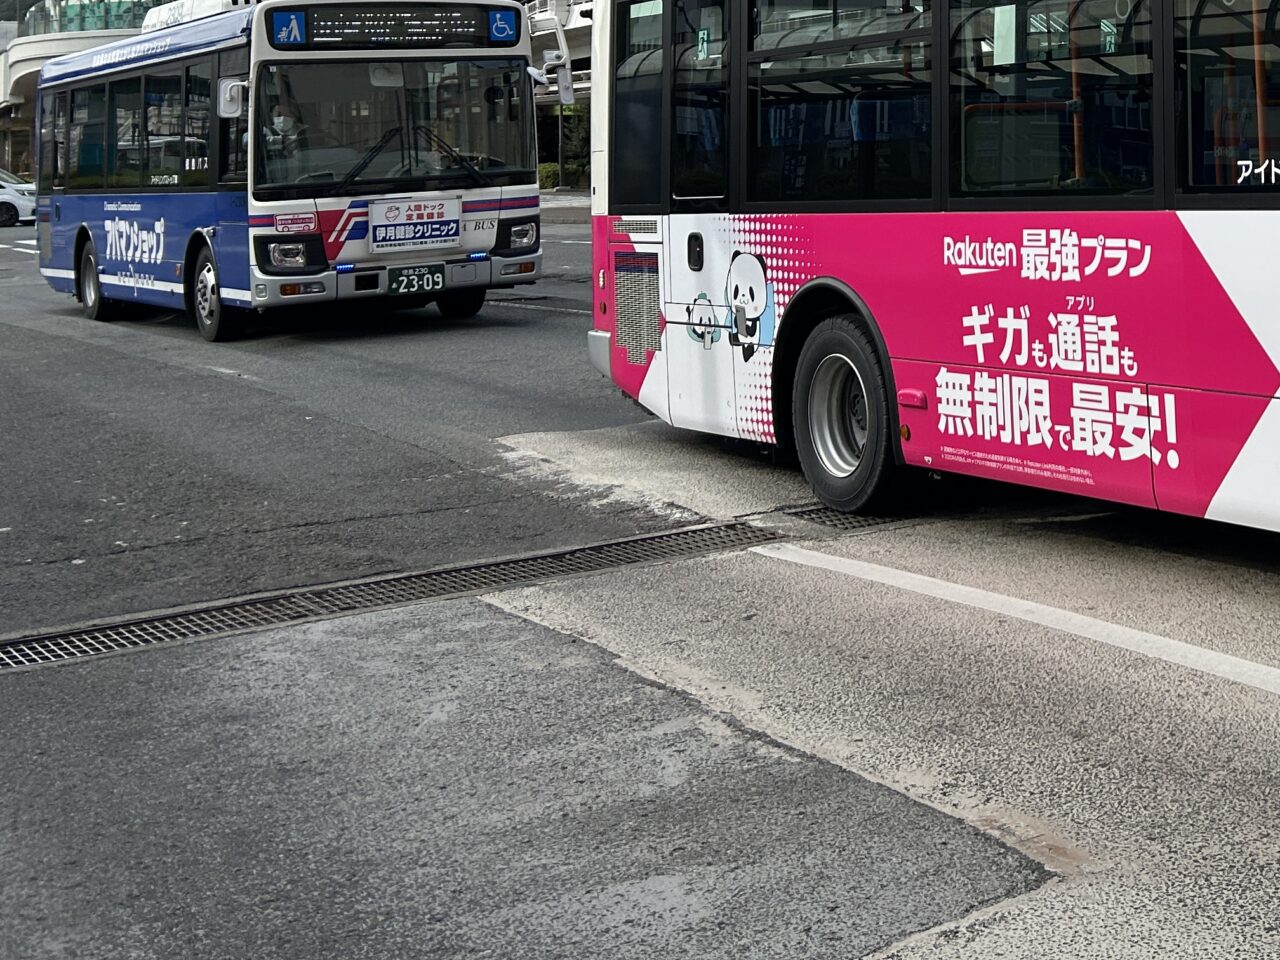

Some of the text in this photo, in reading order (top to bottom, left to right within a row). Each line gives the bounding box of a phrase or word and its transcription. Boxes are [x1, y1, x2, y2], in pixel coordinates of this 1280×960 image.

[405, 203, 445, 213] 人間ドック
[376, 222, 457, 241] 伊月健診クリニック
[474, 220, 496, 231] BUS
[104, 216, 165, 264] アパマンショップ
[944, 228, 1152, 282] Rakuten 最強プラン
[398, 273, 443, 293] 23-09
[1066, 295, 1095, 311] アプリ
[962, 304, 1138, 376] ギガも通話も
[935, 366, 1180, 470] 無制限で最安!
